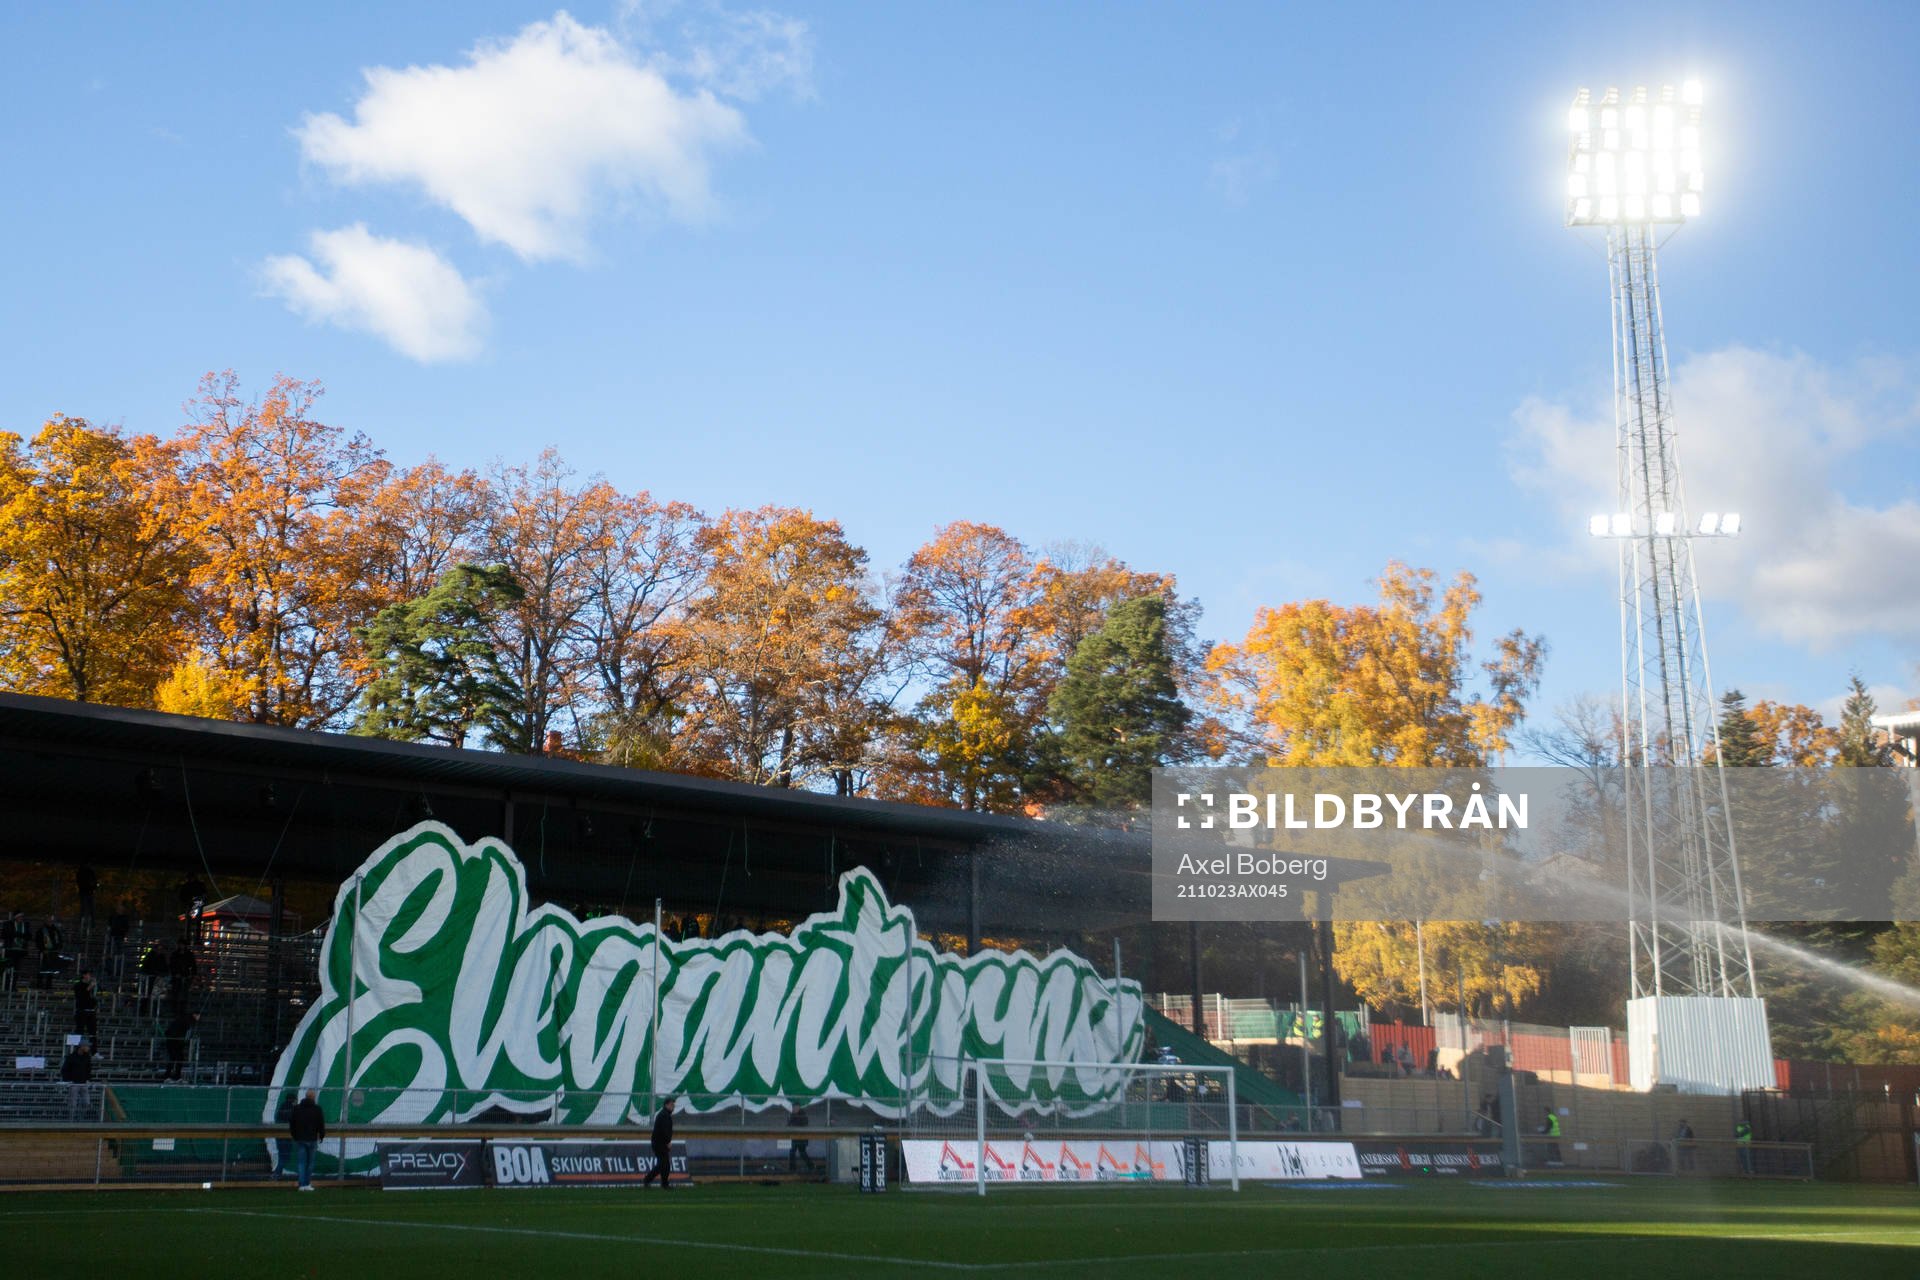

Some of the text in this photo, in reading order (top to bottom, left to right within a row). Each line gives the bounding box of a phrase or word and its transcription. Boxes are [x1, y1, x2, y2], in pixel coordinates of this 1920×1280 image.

[493, 1146, 549, 1184] BOA
[551, 1156, 603, 1173] SKIVOR
[605, 1156, 635, 1173] TILL
[862, 1142, 871, 1188] SELECT
[876, 1142, 885, 1188] SELECT
